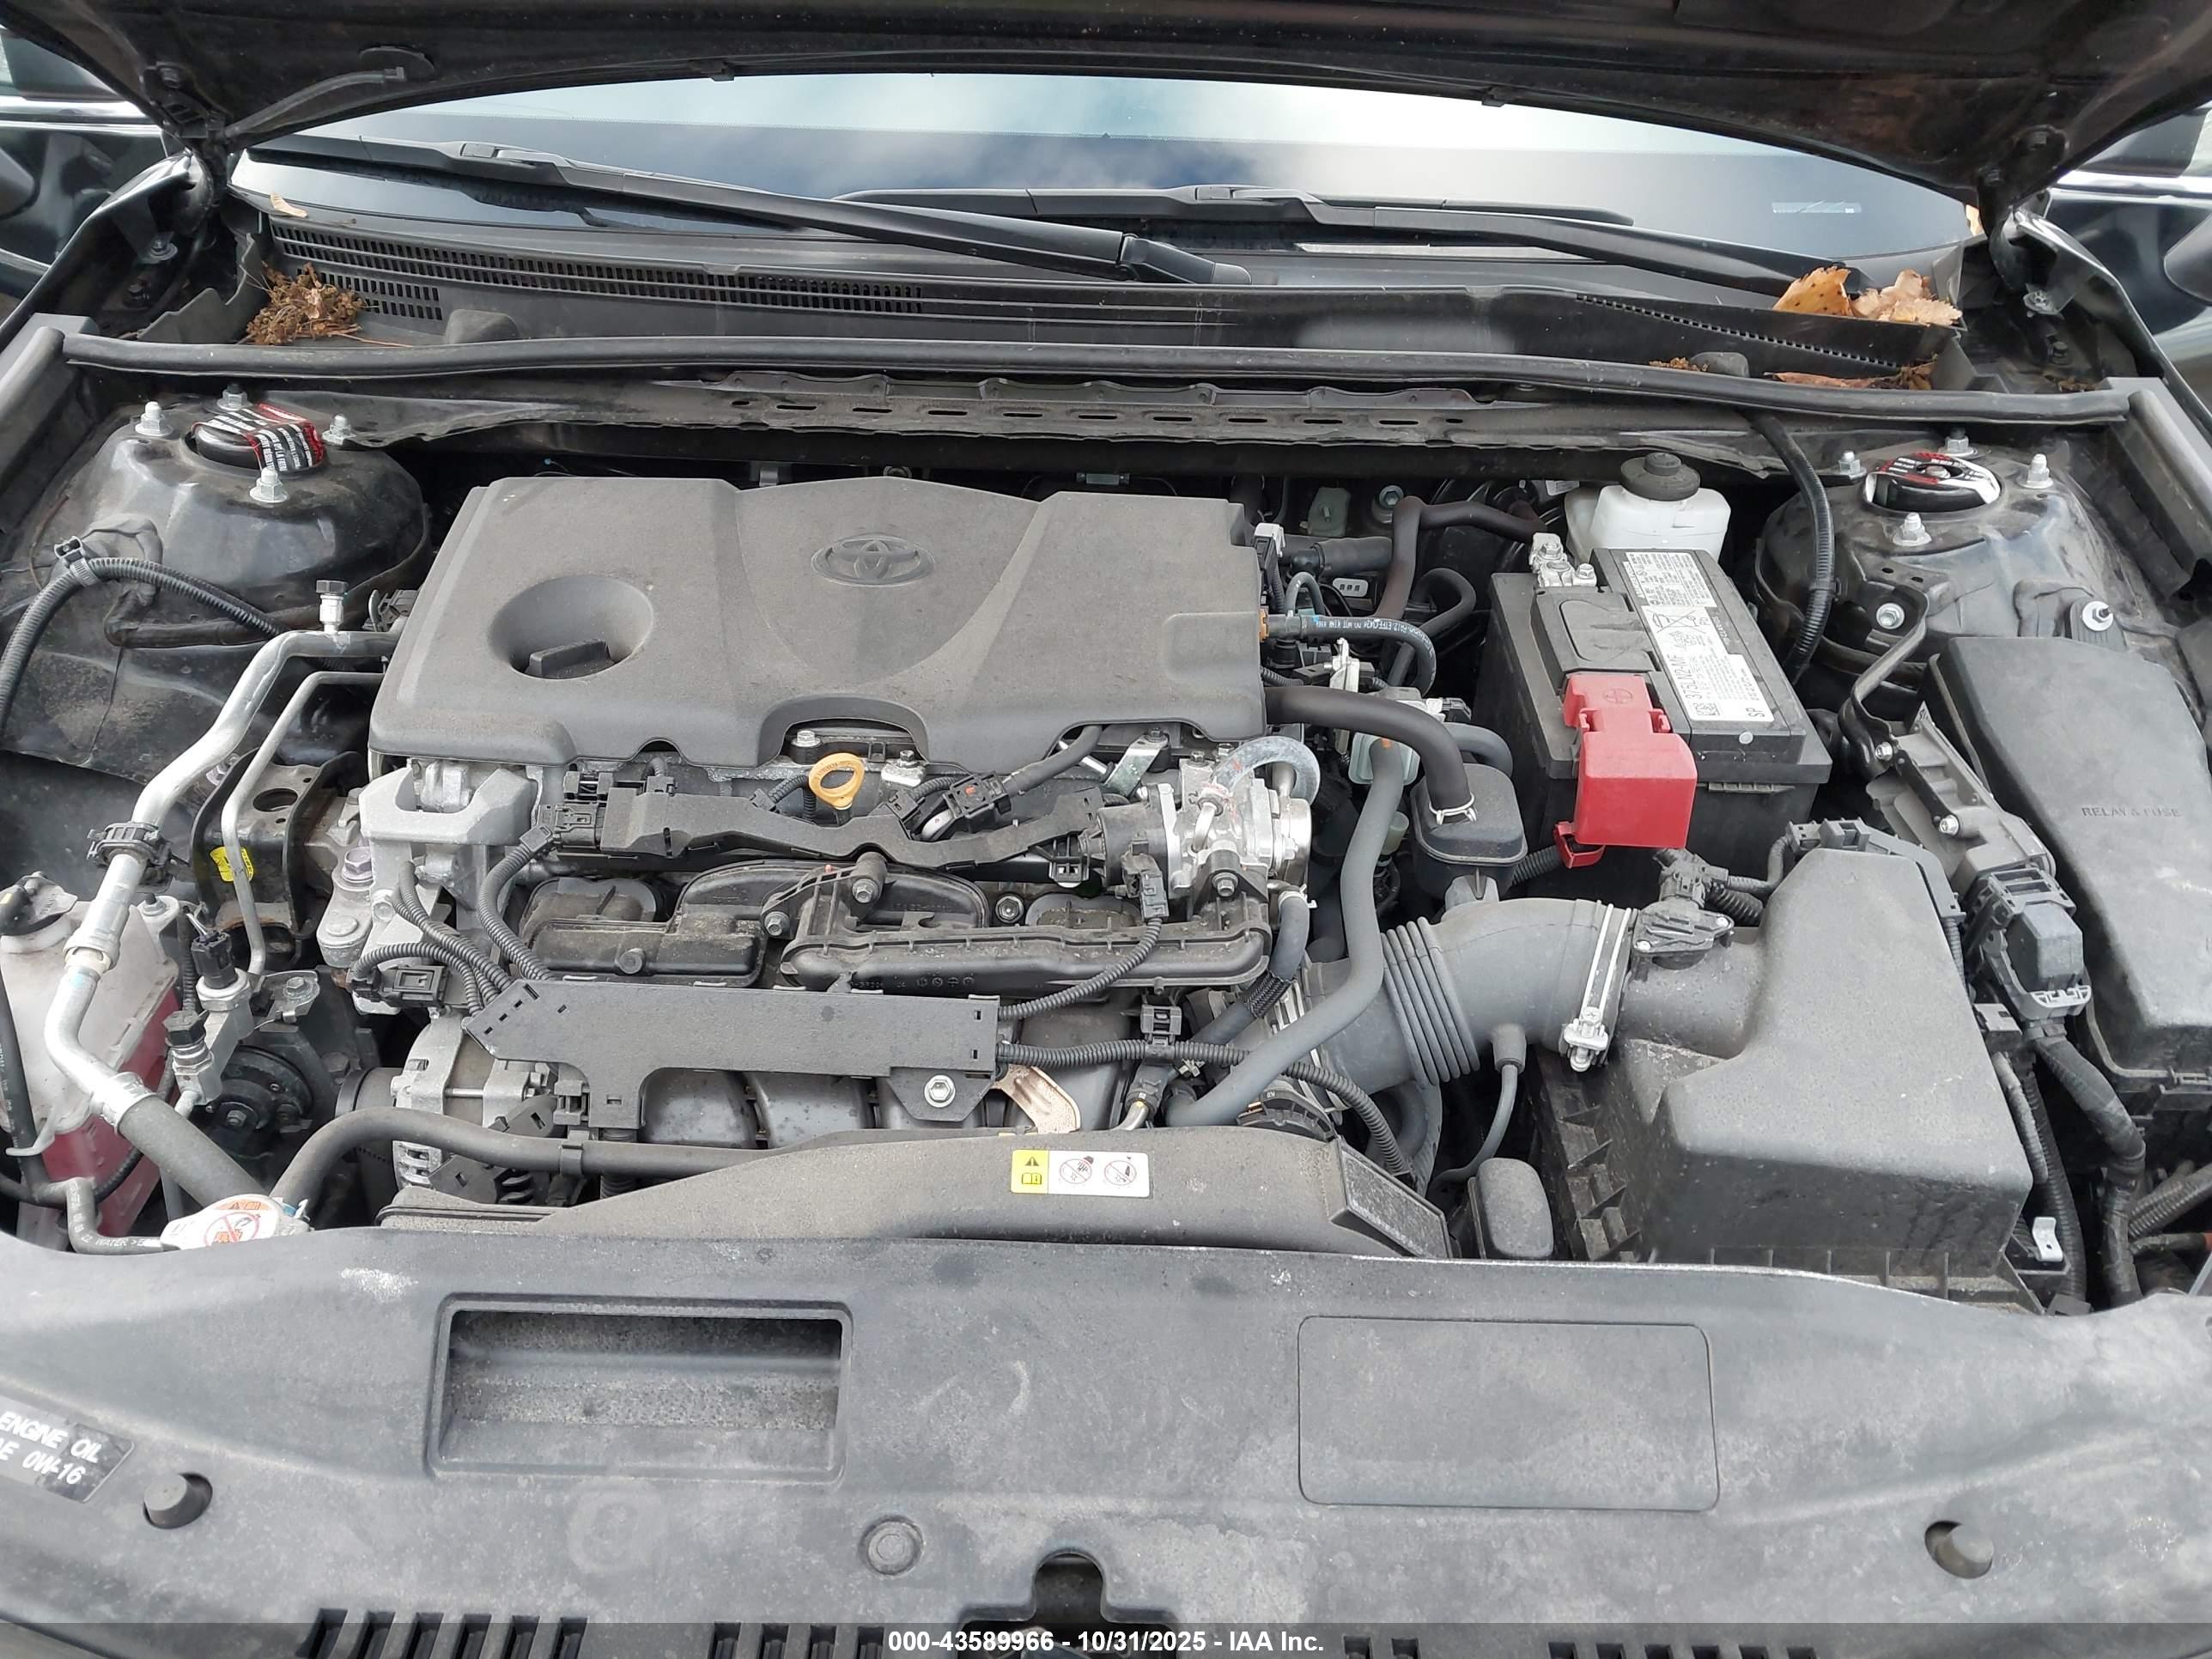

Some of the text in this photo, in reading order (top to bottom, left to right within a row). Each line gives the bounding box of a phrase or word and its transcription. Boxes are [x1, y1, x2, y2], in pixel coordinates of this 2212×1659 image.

[1667, 653, 1703, 700] 375LN2-MF
[1745, 707, 1765, 718] SP
[2081, 806, 2127, 817] RELAY
[70, 1437, 102, 1463] OIL
[21, 1450, 86, 1485] 0W-16
